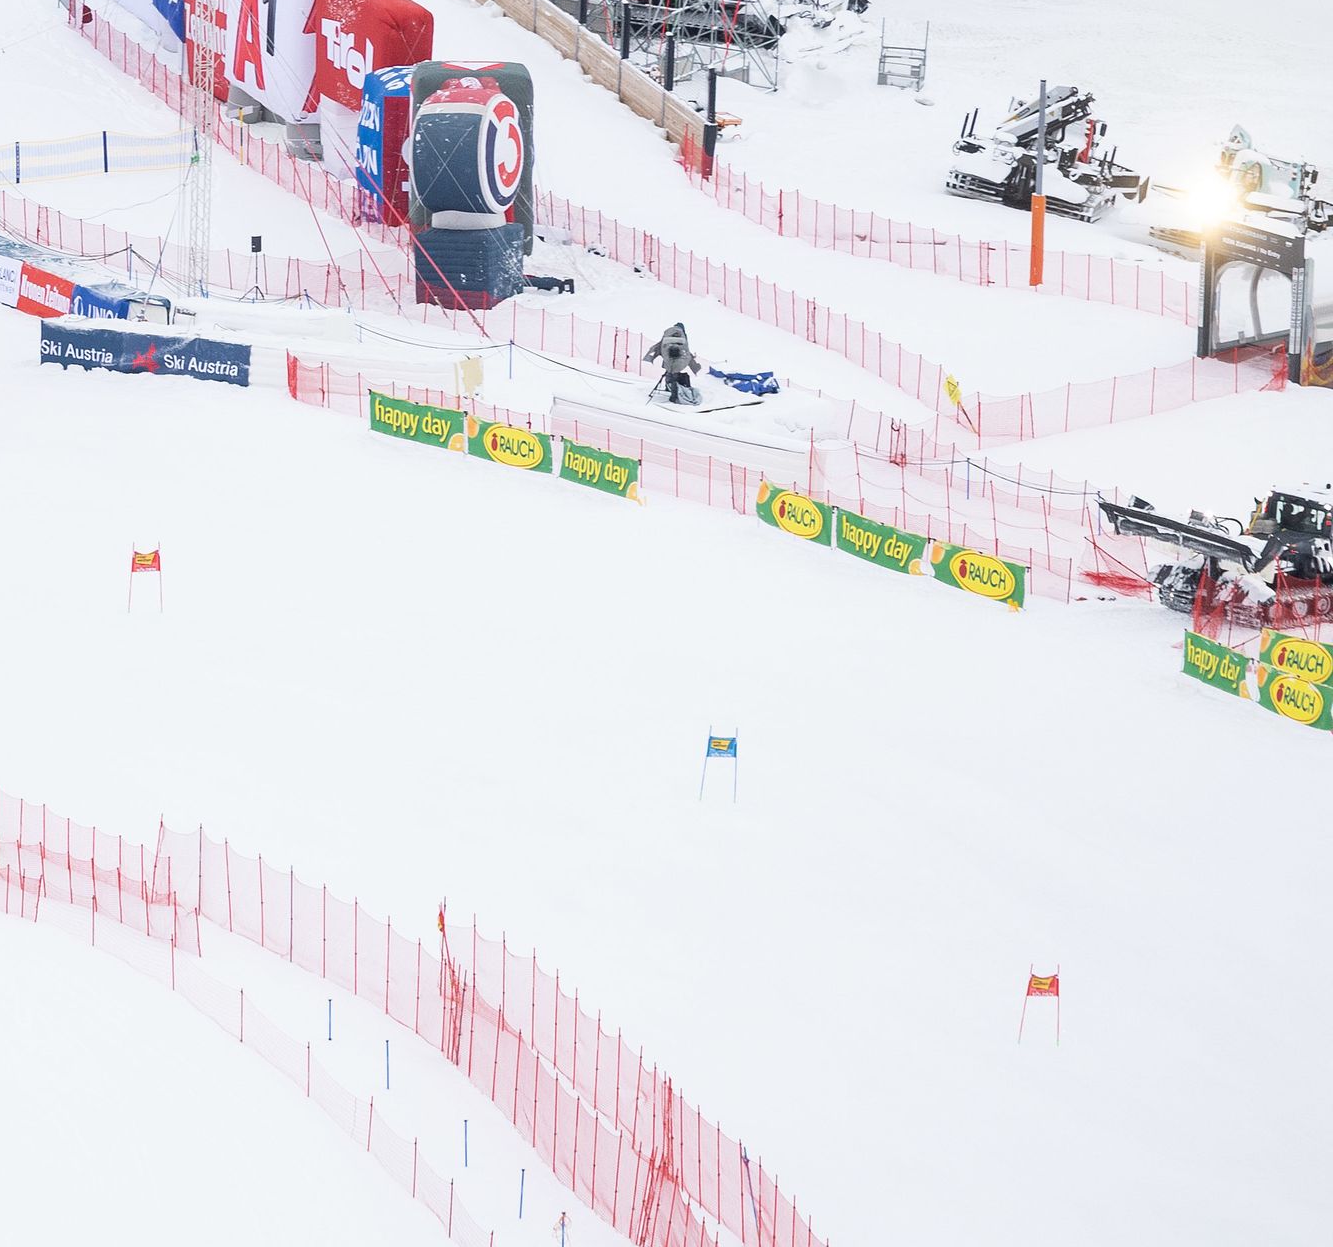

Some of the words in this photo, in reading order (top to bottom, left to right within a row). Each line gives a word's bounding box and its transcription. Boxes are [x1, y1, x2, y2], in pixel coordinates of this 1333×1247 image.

[321, 17, 375, 90] Tirol
[41, 339, 62, 356] Ski
[64, 342, 114, 364] Austria
[163, 353, 185, 371] Ski
[188, 356, 238, 377] Austria
[374, 398, 419, 436] happy
[421, 412, 451, 443] day
[499, 434, 536, 460] RAUCH
[564, 445, 602, 484] happy
[604, 459, 629, 490] day
[786, 502, 817, 530] RAUCH
[841, 514, 883, 558] happy
[884, 533, 913, 567] day
[968, 561, 1007, 591] RAUCH
[1186, 638, 1219, 681] happy
[1219, 660, 1240, 688] day
[1285, 653, 1325, 675] RAUCH
[1283, 689, 1316, 716] RAUCH
